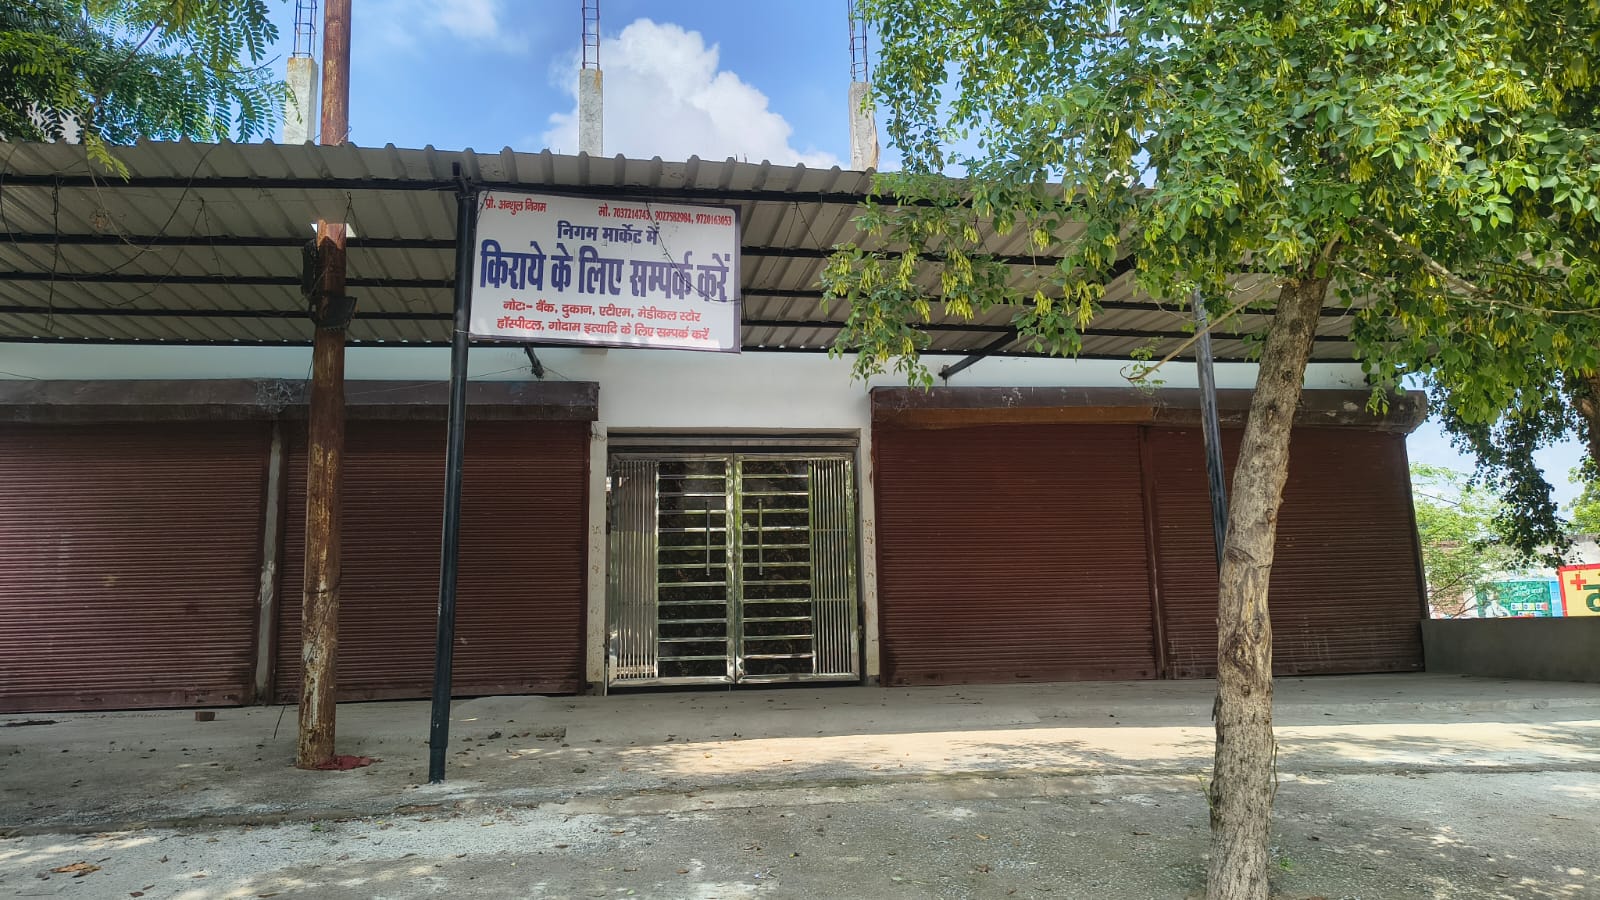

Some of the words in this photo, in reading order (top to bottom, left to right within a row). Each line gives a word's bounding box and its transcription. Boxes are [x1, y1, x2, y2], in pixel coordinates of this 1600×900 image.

[525, 198, 547, 212] निगम
[598, 203, 611, 217] मो.
[557, 220, 598, 241] निगम
[602, 223, 643, 244] मार्केट
[646, 222, 661, 245] में
[480, 239, 547, 291] किराये
[551, 242, 573, 294] के
[578, 245, 624, 296] लिए
[630, 250, 693, 300] सम्पर्क
[697, 252, 731, 302] करें
[536, 299, 558, 313] बैंक,
[562, 303, 596, 318] दुकान,
[599, 304, 634, 318] एटीएम,
[638, 306, 677, 321] मेडीकल
[679, 309, 702, 322] स्टोर
[497, 316, 545, 331] हॉस्पीटल,
[548, 319, 581, 333] गोदाम
[584, 320, 618, 334] इत्यादि
[620, 321, 632, 335] के
[634, 322, 653, 337] लिए
[656, 325, 690, 339] सम्पर्क
[691, 326, 710, 340] करें
